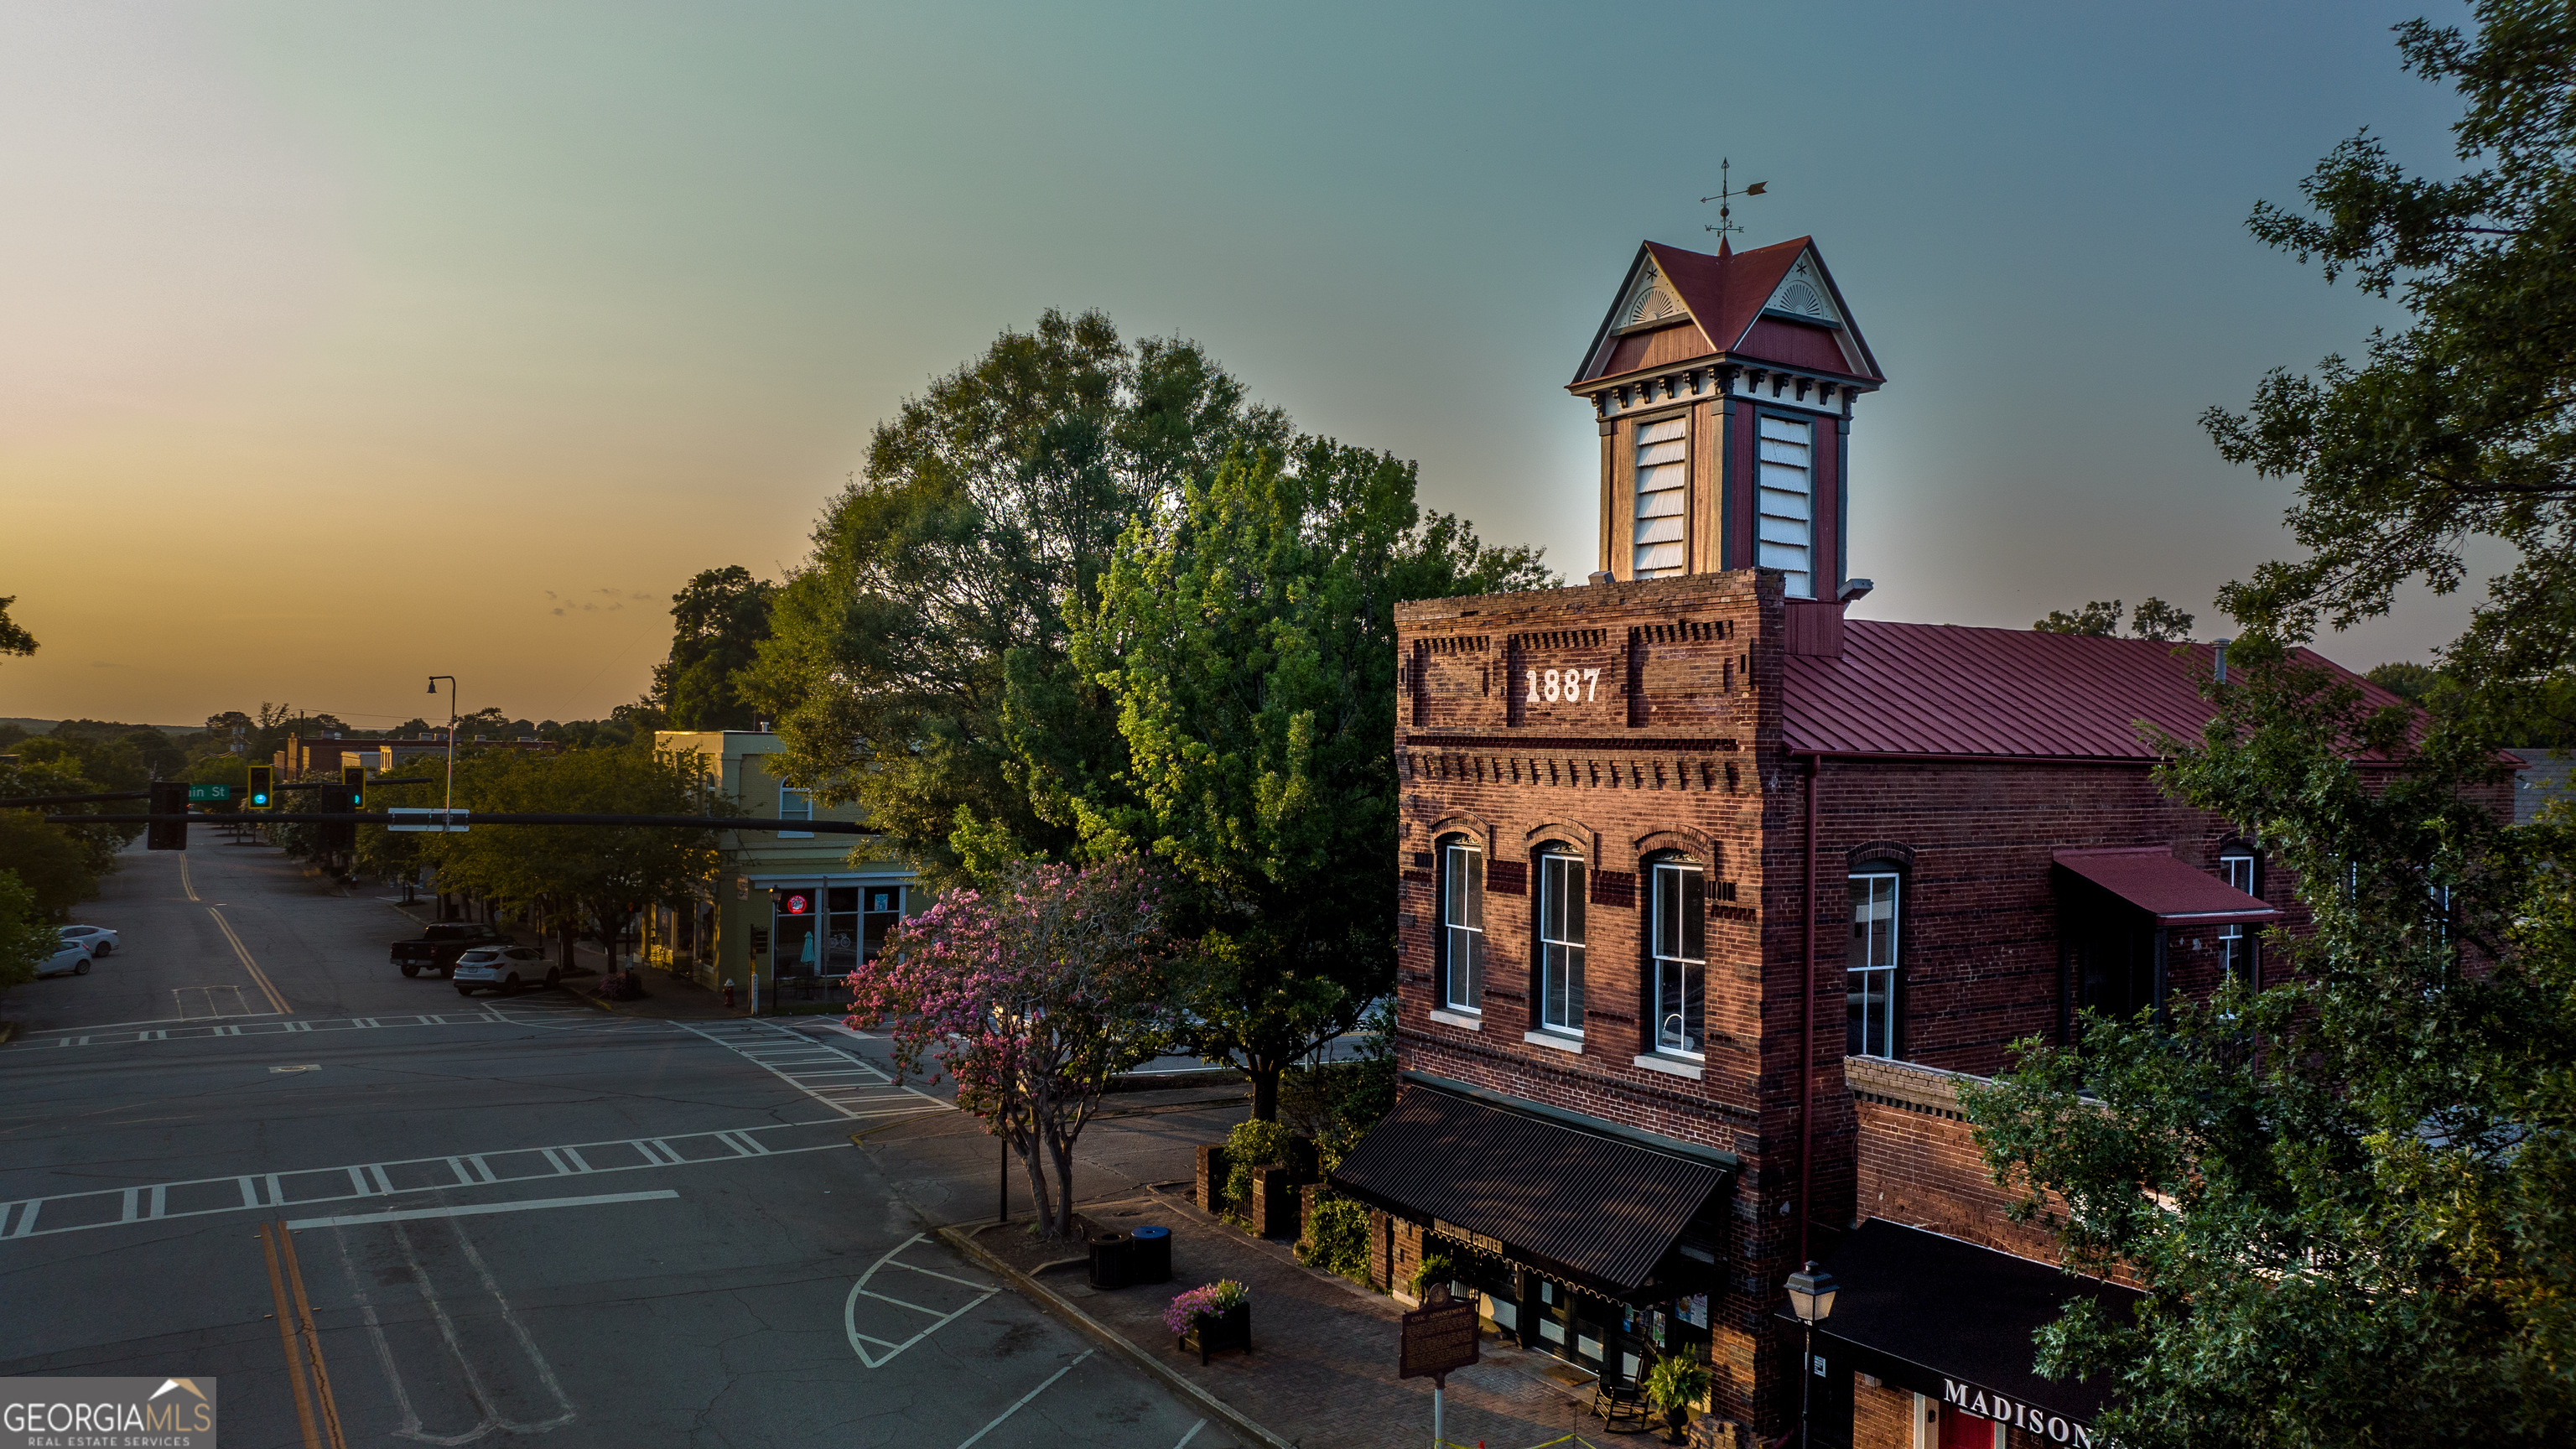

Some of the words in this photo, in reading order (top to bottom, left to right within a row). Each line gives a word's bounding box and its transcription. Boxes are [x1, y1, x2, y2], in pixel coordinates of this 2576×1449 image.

[1705, 224, 1712, 232] W
[1526, 667, 1602, 703] 1887
[212, 787, 225, 797] St
[1434, 1217, 1472, 1243] WELCOME
[1472, 1232, 1503, 1254] CENTER
[1410, 1314, 1426, 1322] CIVIC
[1429, 1307, 1467, 1319] ADVANCEMENT
[1944, 1378, 2093, 1449] MADISON
